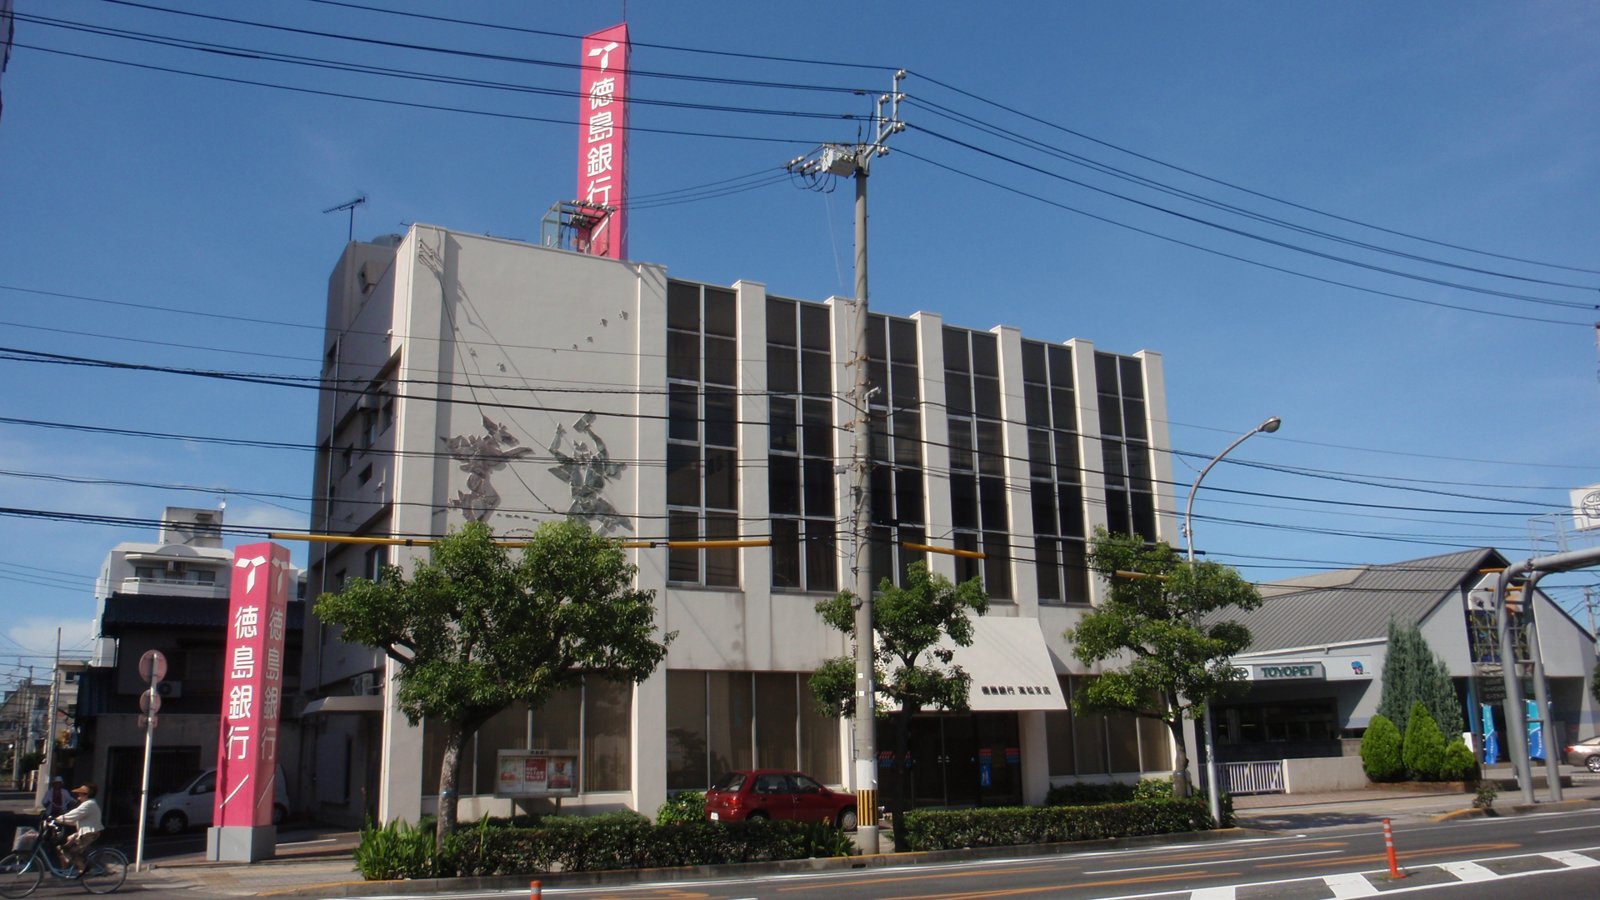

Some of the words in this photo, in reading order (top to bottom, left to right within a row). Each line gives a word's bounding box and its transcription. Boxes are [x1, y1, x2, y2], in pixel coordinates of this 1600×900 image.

[587, 77, 615, 207] 徳島銀行
[227, 605, 258, 760] 徳島銀行
[261, 607, 283, 760] 徳島銀行
[1261, 665, 1314, 678] TOYOPET
